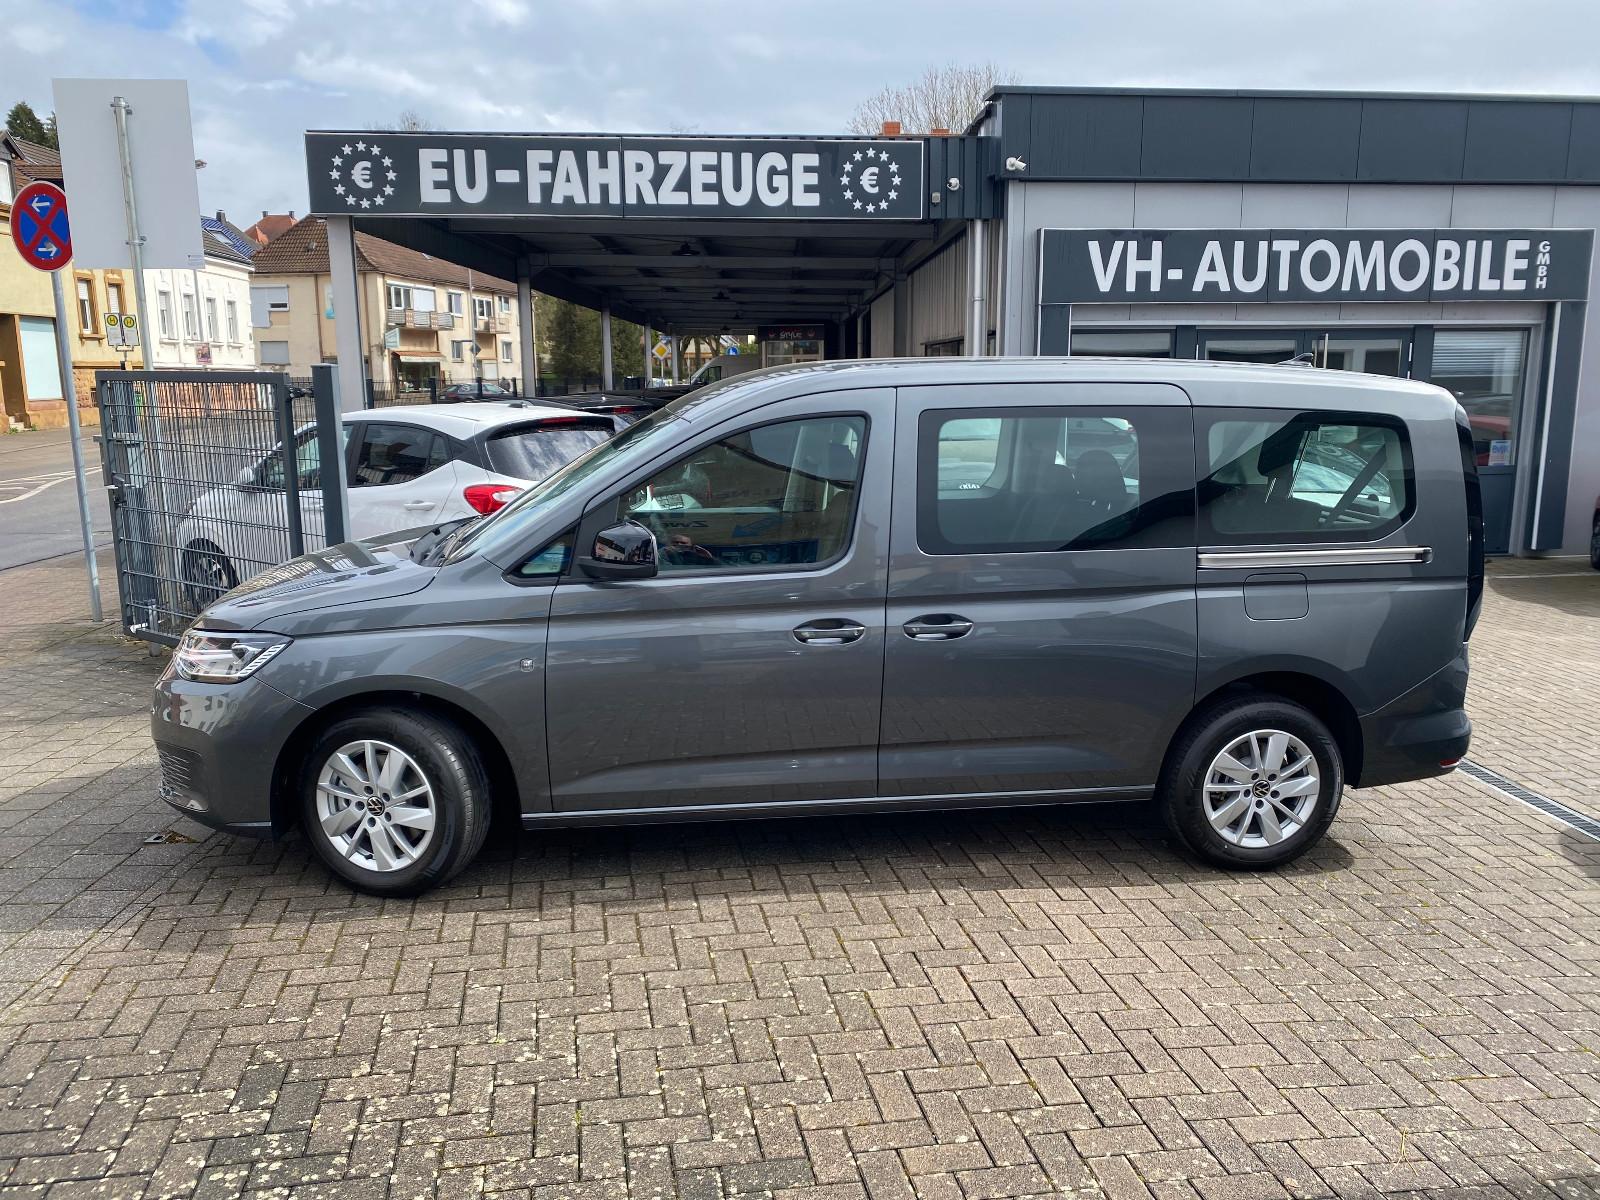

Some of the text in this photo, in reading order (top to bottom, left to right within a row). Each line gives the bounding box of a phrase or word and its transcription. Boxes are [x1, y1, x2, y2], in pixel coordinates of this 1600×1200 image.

[352, 160, 373, 189] €
[418, 148, 821, 207] EU-FAHRZEUGE
[859, 166, 879, 194] €
[1192, 238, 1531, 293] AUTOMOBILE
[1536, 240, 1551, 289] GMBH
